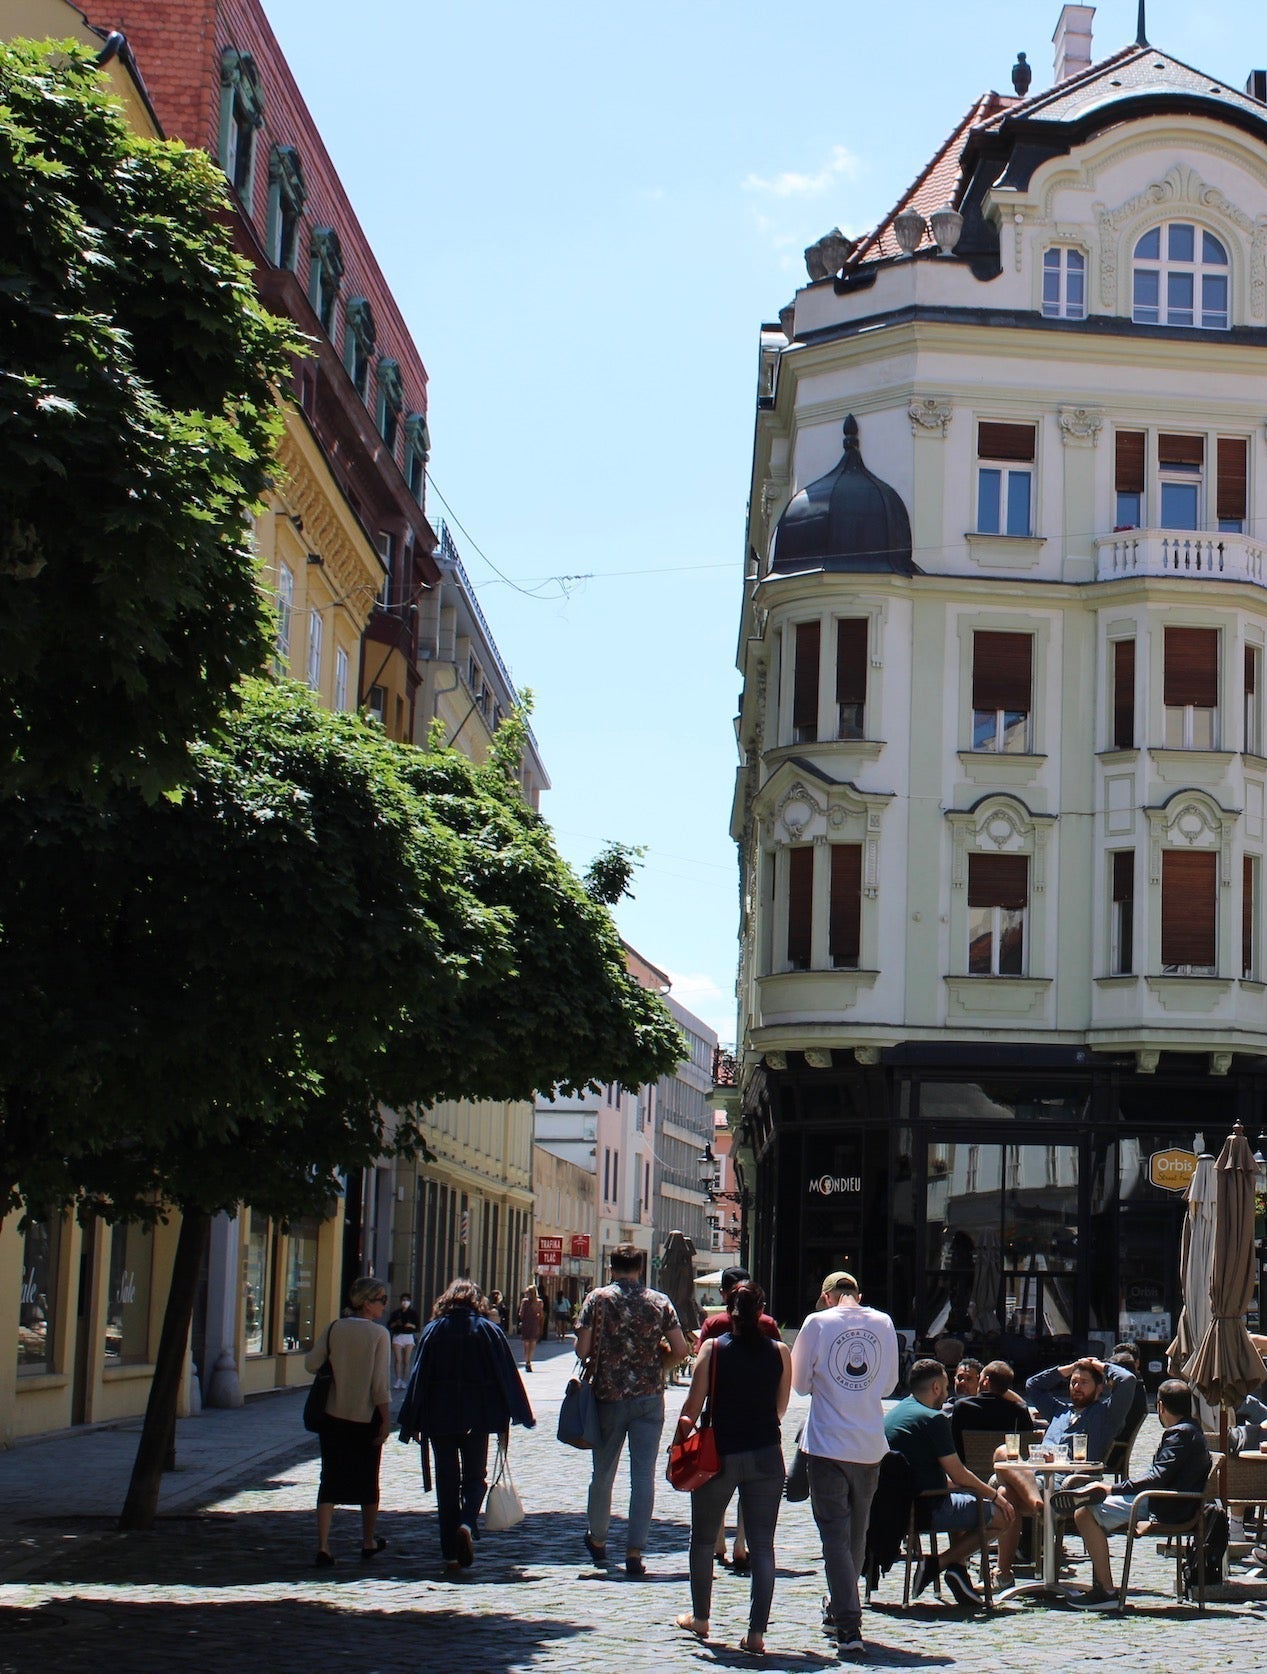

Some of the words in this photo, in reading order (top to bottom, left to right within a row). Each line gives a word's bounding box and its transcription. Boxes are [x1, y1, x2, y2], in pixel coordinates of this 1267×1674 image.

[1157, 1158, 1193, 1171] Orbis
[809, 1174, 861, 1195] MONDIEU
[540, 1239, 561, 1249] TRAFIKA
[116, 1270, 136, 1303] Sale
[863, 1332, 877, 1345] LIFE
